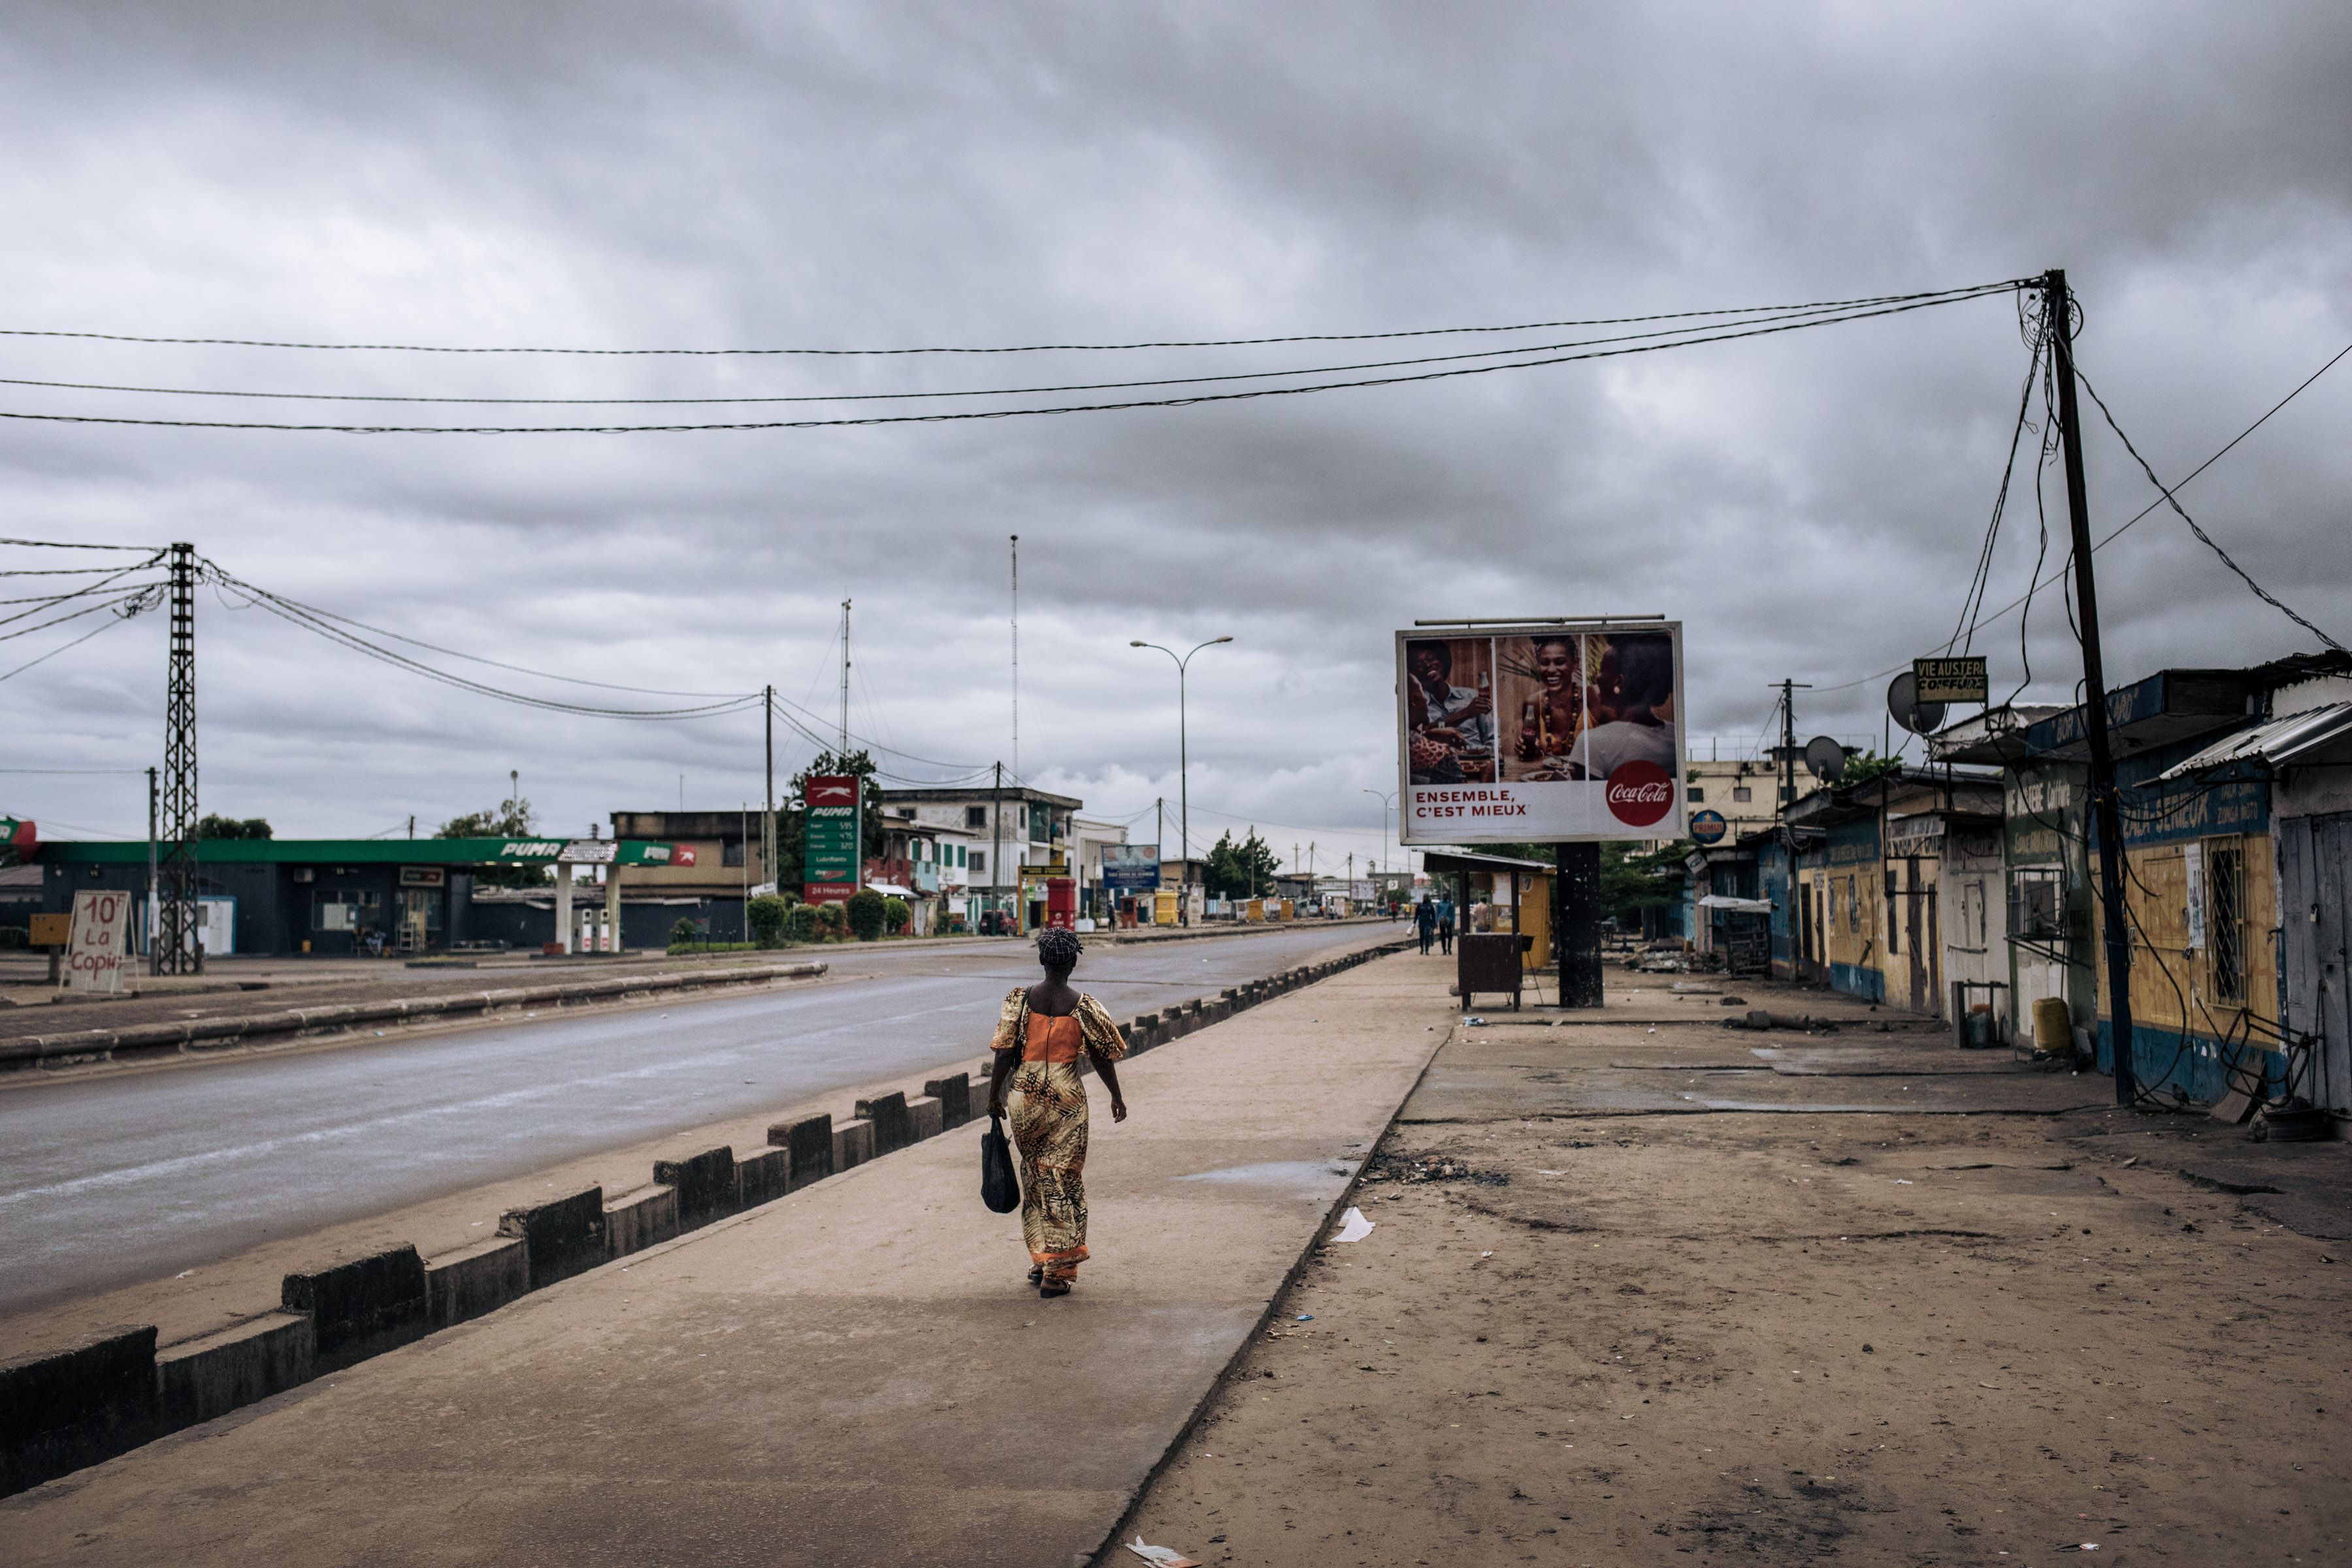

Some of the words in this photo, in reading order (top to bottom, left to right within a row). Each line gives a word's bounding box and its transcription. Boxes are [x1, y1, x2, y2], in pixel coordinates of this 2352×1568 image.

[1918, 662, 1936, 676] VIE
[1416, 790, 1516, 803] ENSEMBLE,
[1609, 782, 1671, 804] Coca-Cola
[811, 807, 853, 817] PUMA
[1416, 806, 1465, 817] C'EST
[1471, 804, 1527, 817] MIEUX
[1694, 823, 1724, 833] PRIMUS
[500, 842, 561, 857] PUMA
[823, 887, 850, 895] Heures
[85, 928, 110, 946] La
